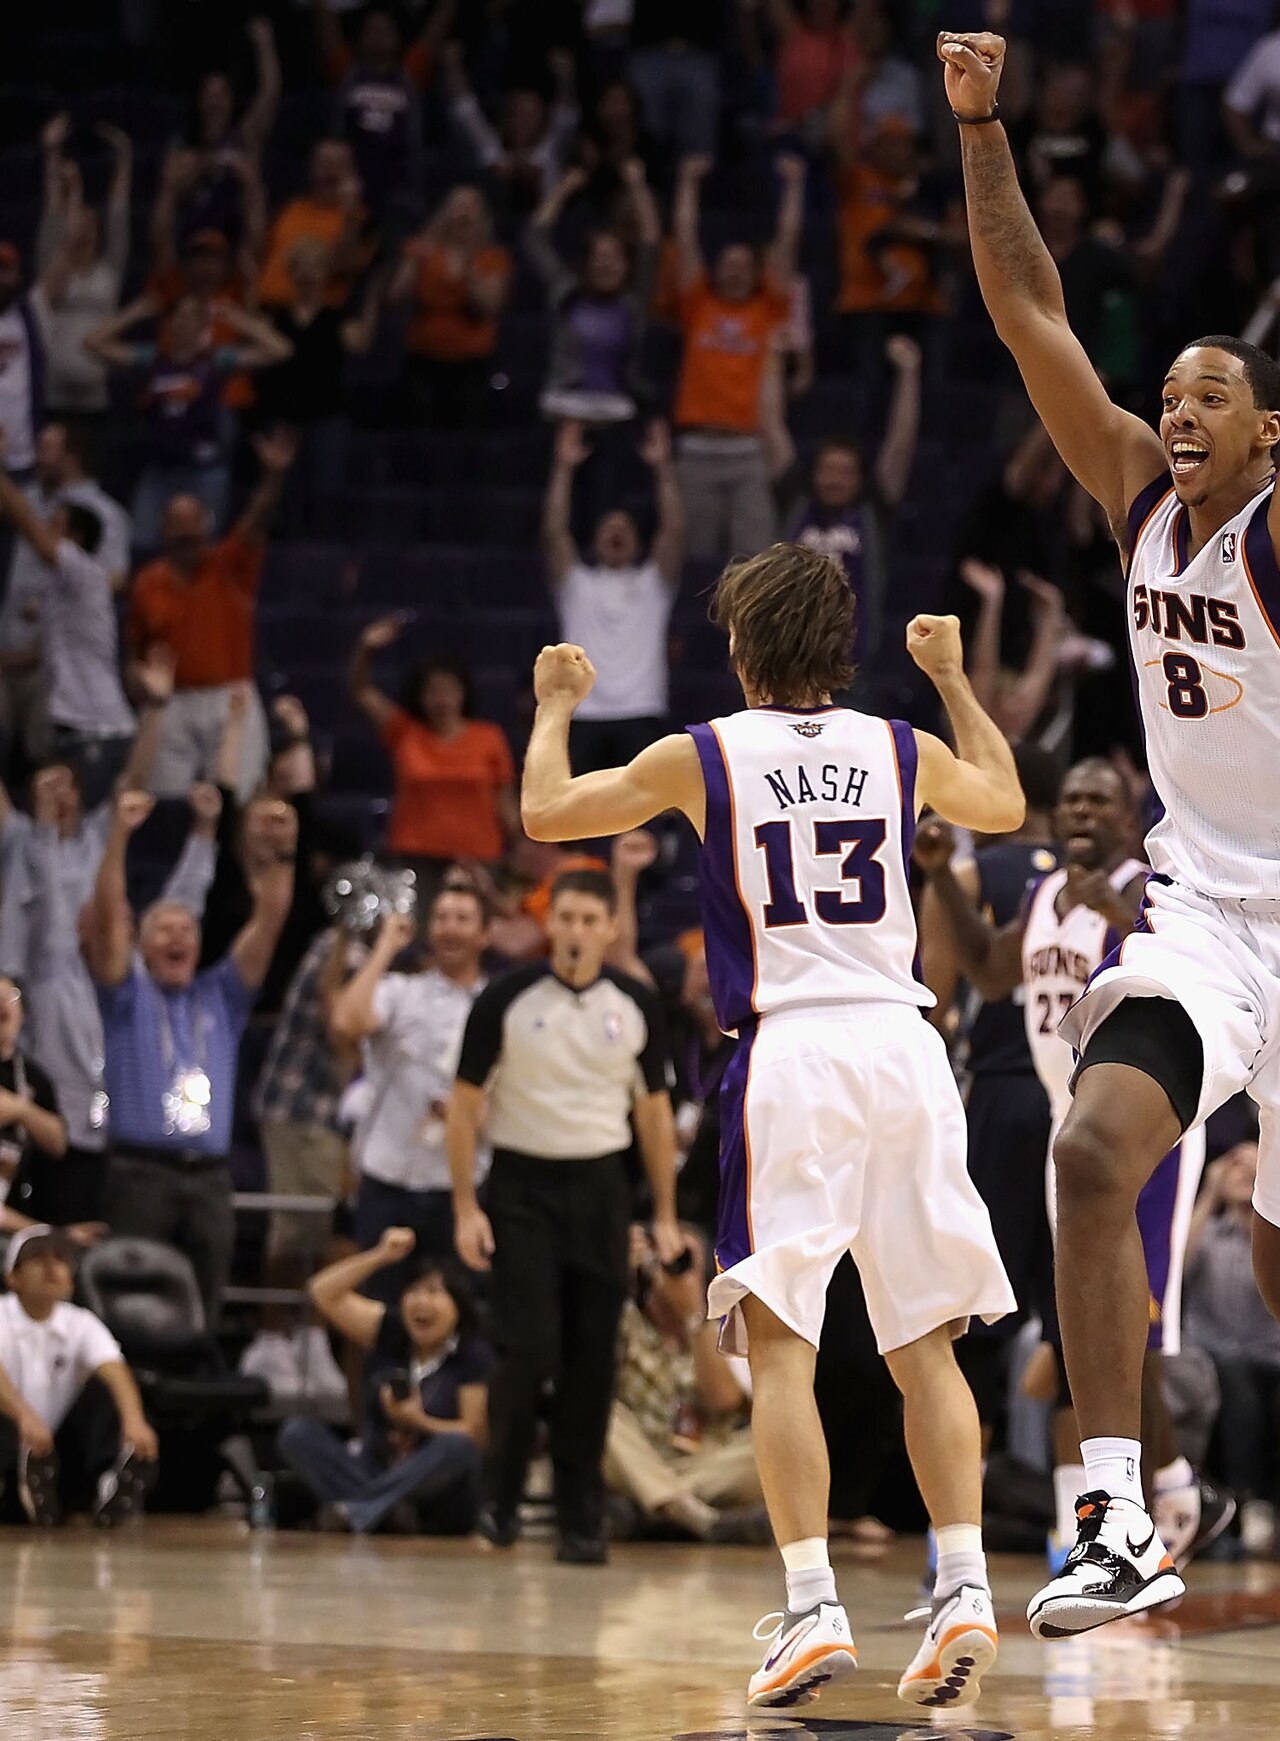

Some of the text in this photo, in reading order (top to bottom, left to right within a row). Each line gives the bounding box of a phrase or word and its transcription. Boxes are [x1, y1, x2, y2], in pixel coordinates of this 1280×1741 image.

[1133, 584, 1246, 650] SUNS
[1163, 652, 1210, 721] 8
[764, 764, 869, 809] NASH
[753, 817, 887, 928] 13
